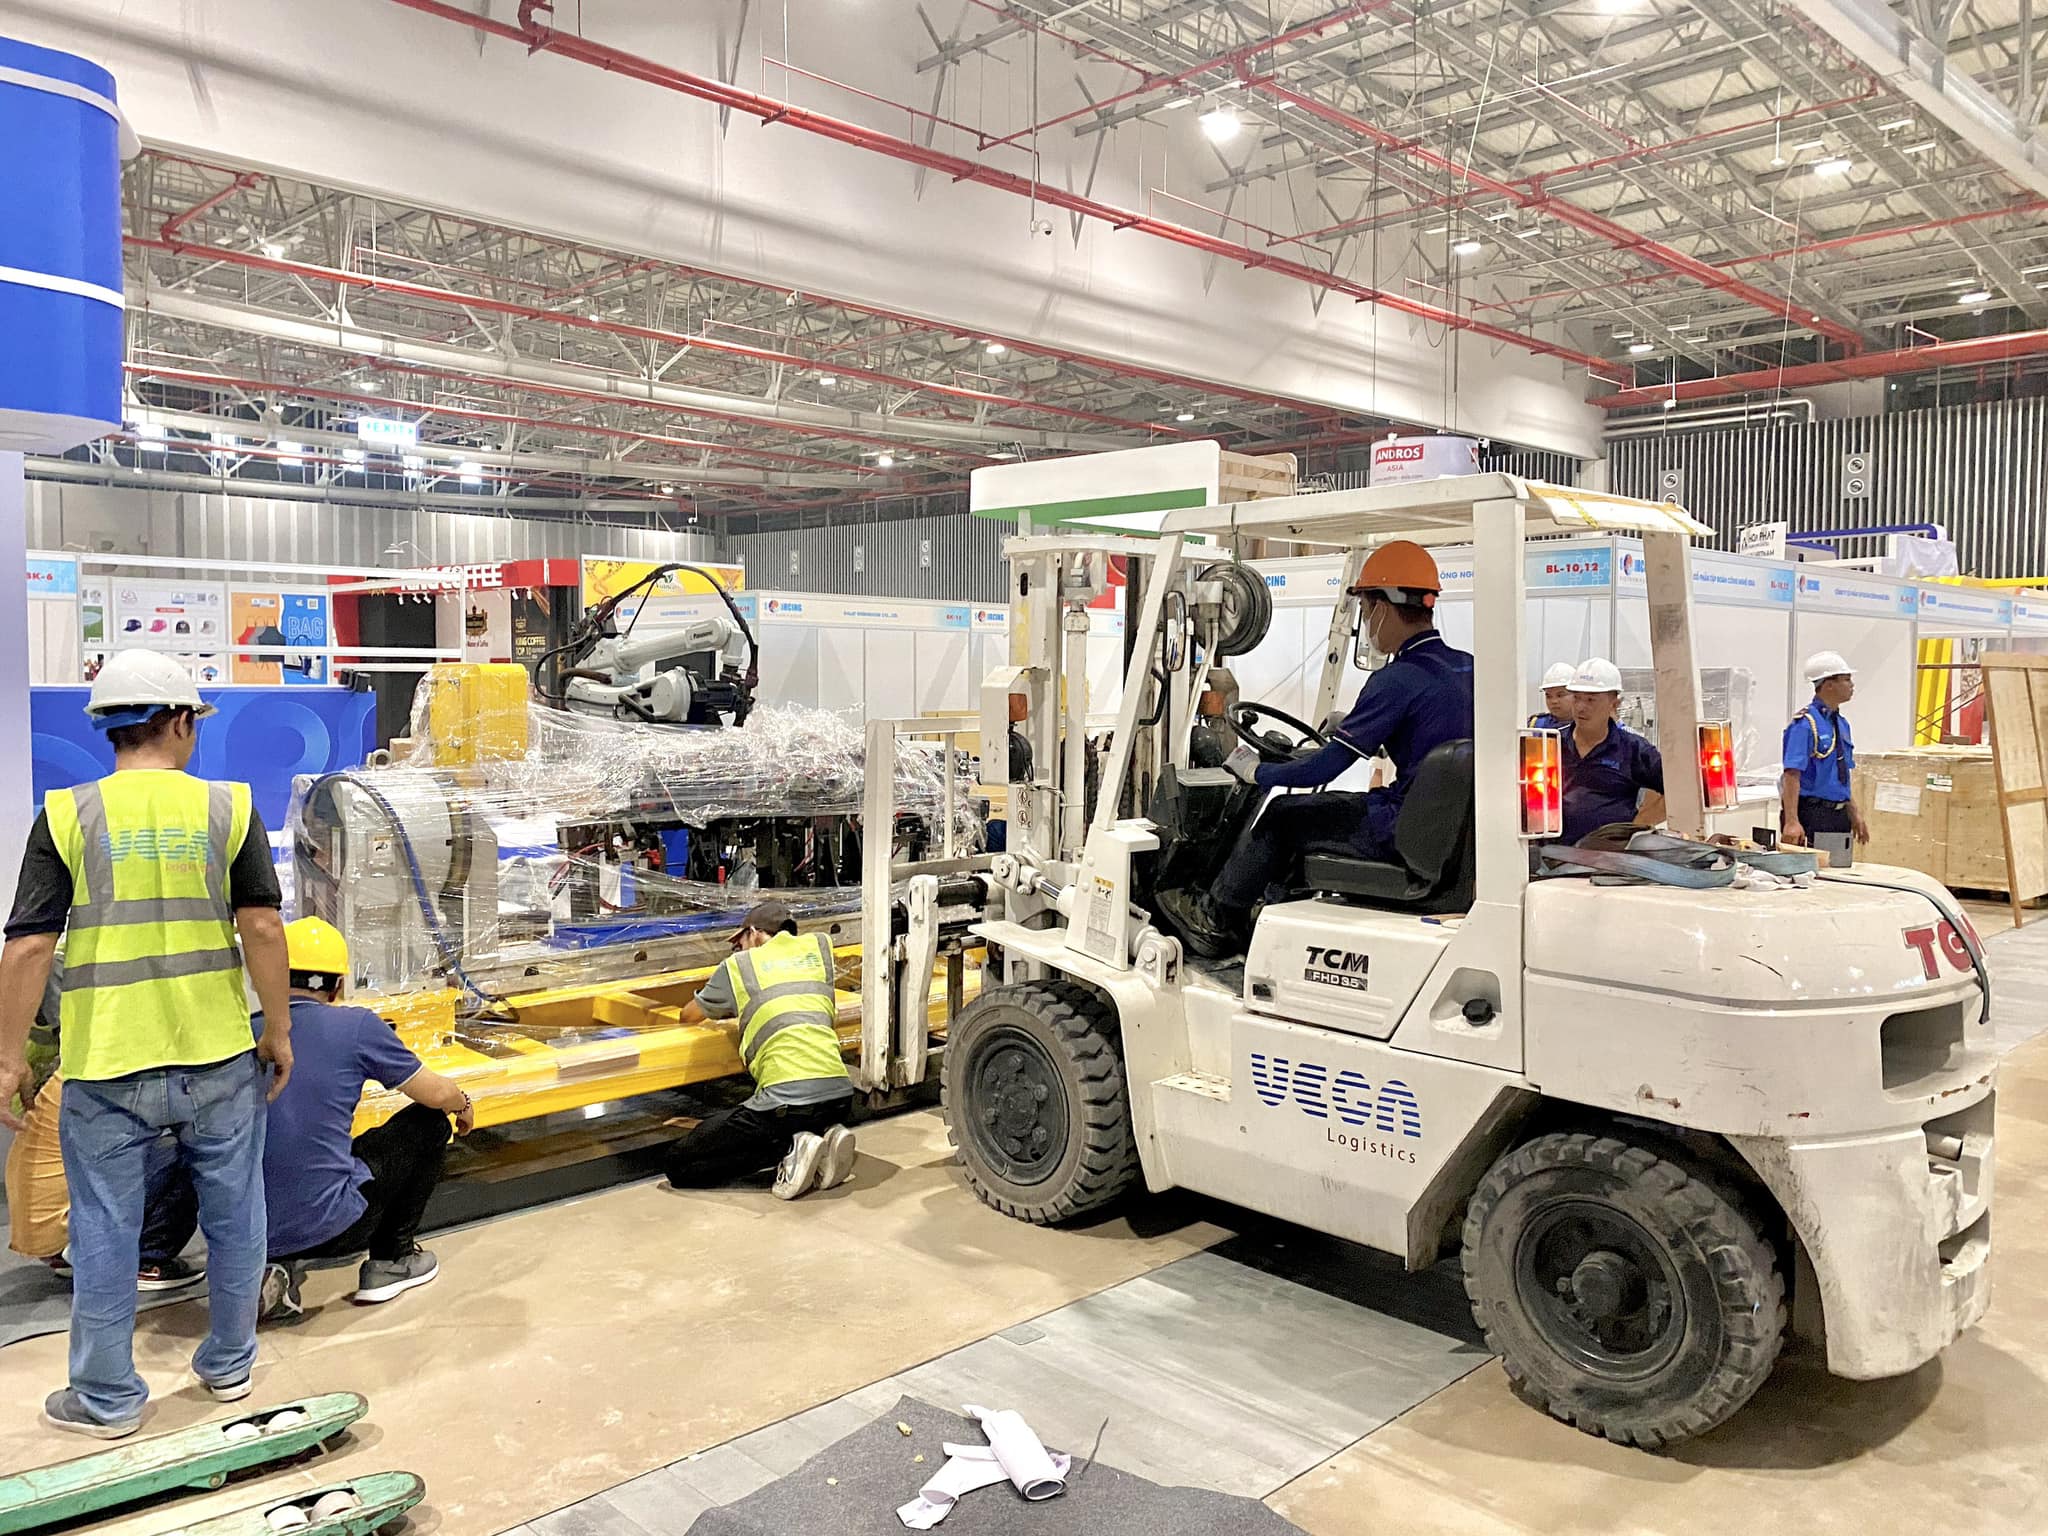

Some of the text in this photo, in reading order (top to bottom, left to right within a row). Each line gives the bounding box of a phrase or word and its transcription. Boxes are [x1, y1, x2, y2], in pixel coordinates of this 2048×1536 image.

[373, 422, 405, 434] EXIT
[1377, 447, 1420, 460] ANDROS
[1387, 464, 1404, 472] ASIA
[1546, 563, 1598, 574] BL-10,12
[288, 616, 323, 639] BAG
[1305, 946, 1369, 974] TCM
[1312, 971, 1359, 987] FHD35
[1327, 1127, 1416, 1164] Logistics
